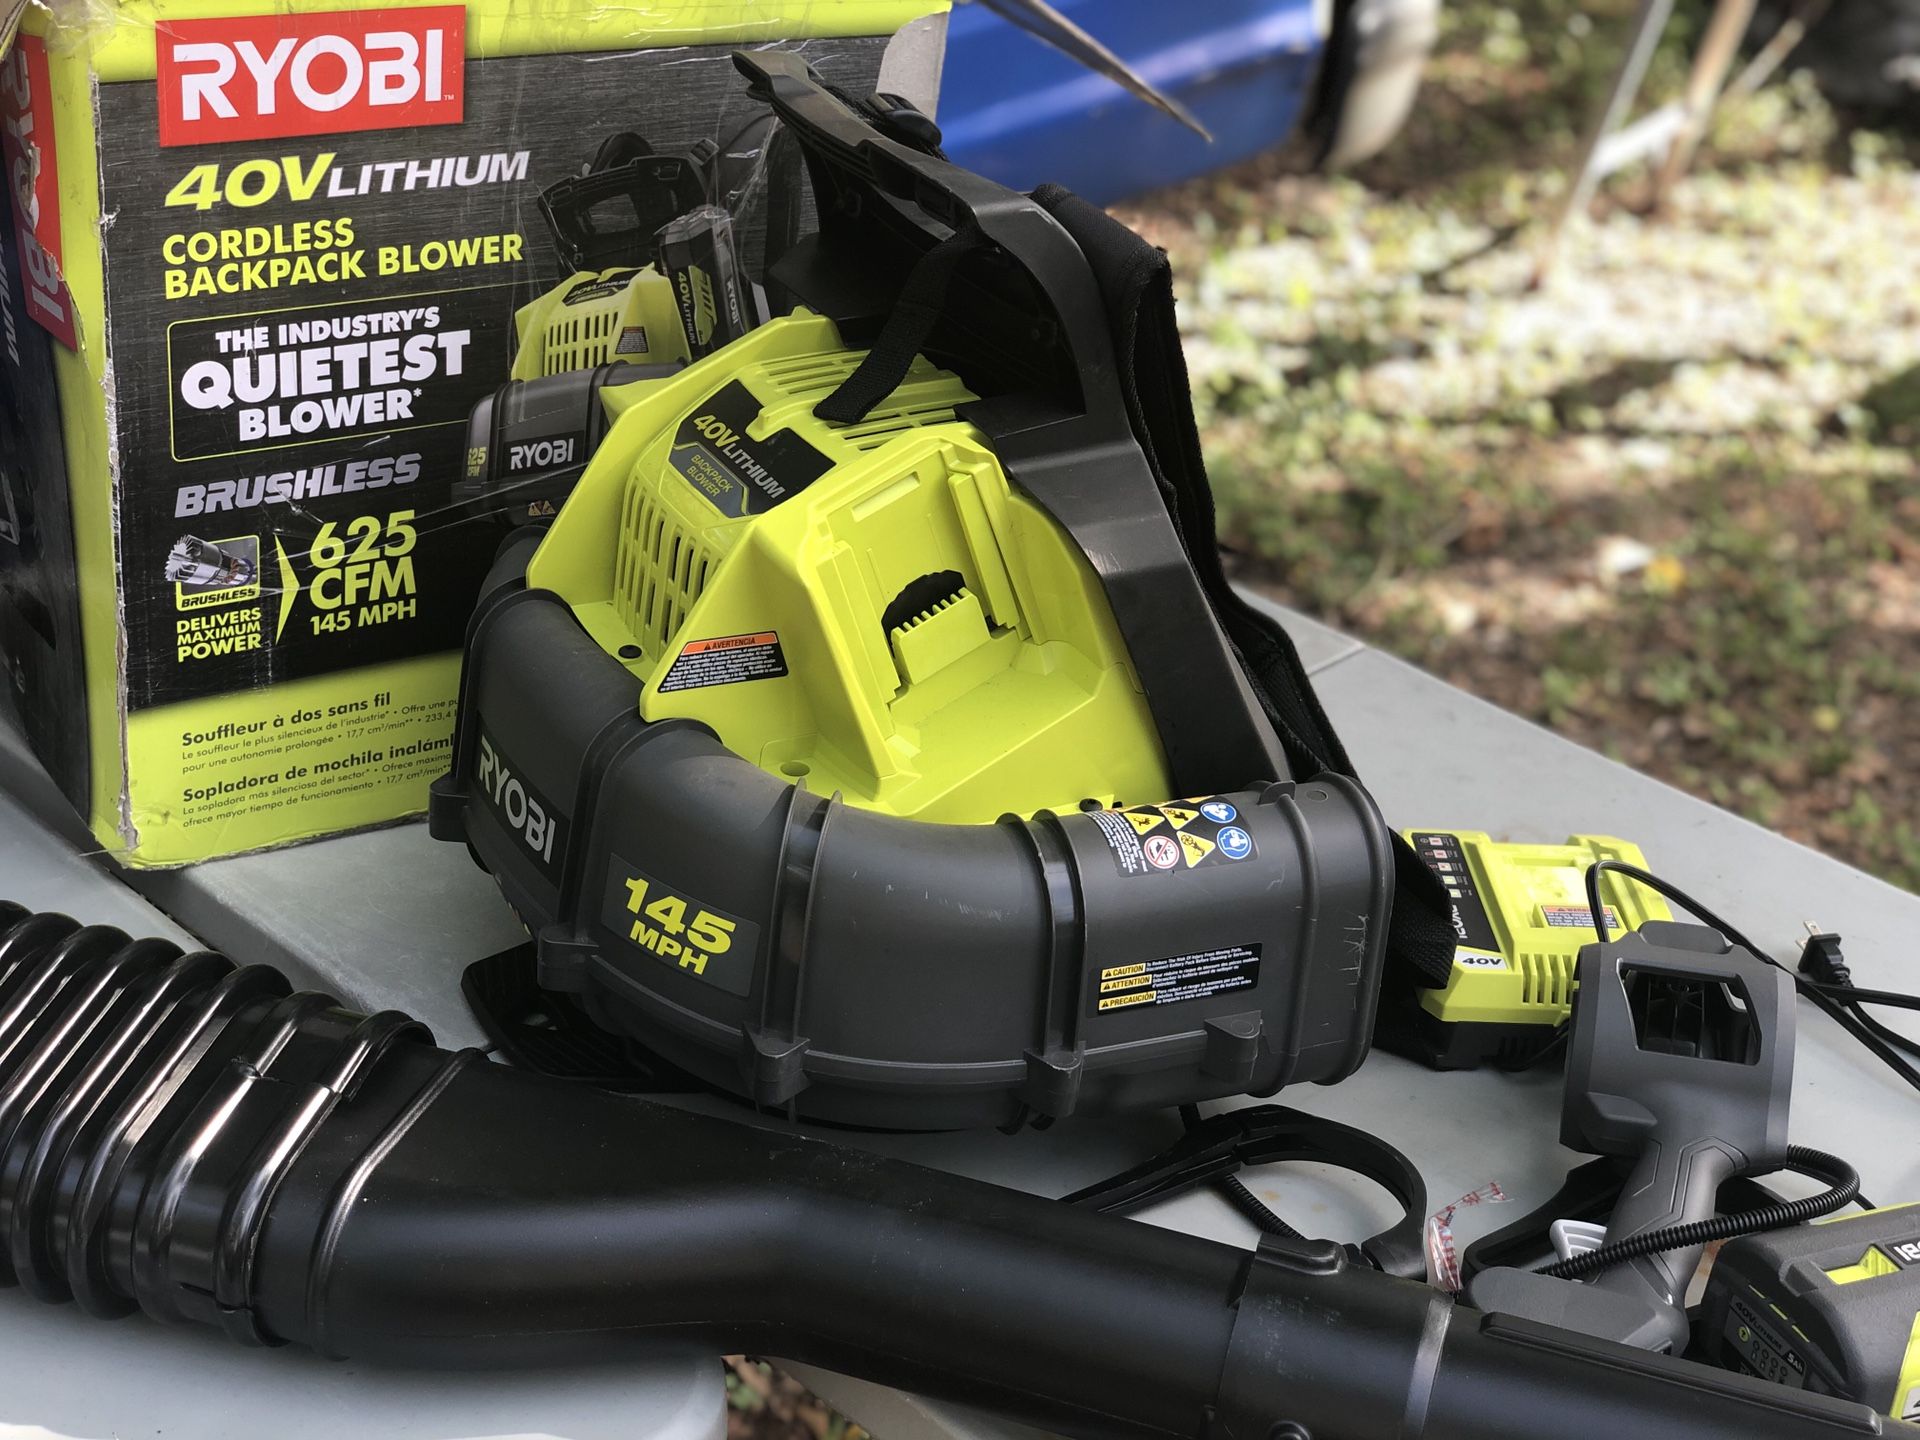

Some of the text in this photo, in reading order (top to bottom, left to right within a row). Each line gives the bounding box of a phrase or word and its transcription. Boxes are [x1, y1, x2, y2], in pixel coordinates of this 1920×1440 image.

[173, 29, 443, 121] RYOBI
[162, 218, 354, 265] CORDLESS
[165, 233, 523, 299] BACKPACK BLOWER
[215, 307, 441, 354] THE INDUSTRY'S
[180, 330, 471, 410] QUIETEST
[510, 438, 574, 470] RYOBI
[691, 455, 733, 493] BACKPACK
[174, 453, 422, 518] BRUSHLESS
[687, 465, 721, 497] BLOWER
[310, 510, 416, 569] 625
[182, 587, 256, 608] BRUSHLESS
[310, 556, 416, 611] CFM
[176, 607, 261, 634] DELIVERS
[177, 621, 261, 646] MAXIMUM
[310, 599, 416, 635] 145 MPH
[178, 633, 261, 663] POWER
[712, 638, 755, 650] AVERTENCIA
[182, 691, 390, 746] Souffleur à dos sans fil
[182, 751, 194, 760] Le
[197, 743, 240, 758] souffleur
[243, 739, 252, 748] le
[255, 735, 275, 747] plus
[278, 726, 323, 740] silencieux
[326, 721, 338, 730] de
[402, 704, 426, 715] Offre
[428, 700, 446, 709] une
[182, 763, 205, 774] pour
[209, 757, 228, 768] une
[230, 747, 282, 763] autonomie
[285, 735, 334, 753] prolongée
[183, 773, 279, 802] Sopladora
[285, 766, 308, 780] de
[313, 750, 383, 774] mochila
[183, 807, 194, 815] La
[197, 796, 246, 812] sopladora
[272, 781, 317, 796] silenciosa
[320, 776, 335, 787] del
[382, 761, 413, 773] Ofrece
[183, 815, 213, 828] ofrece
[216, 807, 247, 821] mayor
[250, 800, 283, 813] tiempo
[286, 797, 298, 806] de
[301, 781, 373, 803] funcionamiento
[479, 736, 556, 864] RYOBI
[625, 877, 737, 954] 145
[629, 920, 709, 976] MPH
[1113, 965, 1144, 976] CAUTION
[1462, 957, 1502, 965] 40V
[1111, 976, 1150, 988] ATTENTION
